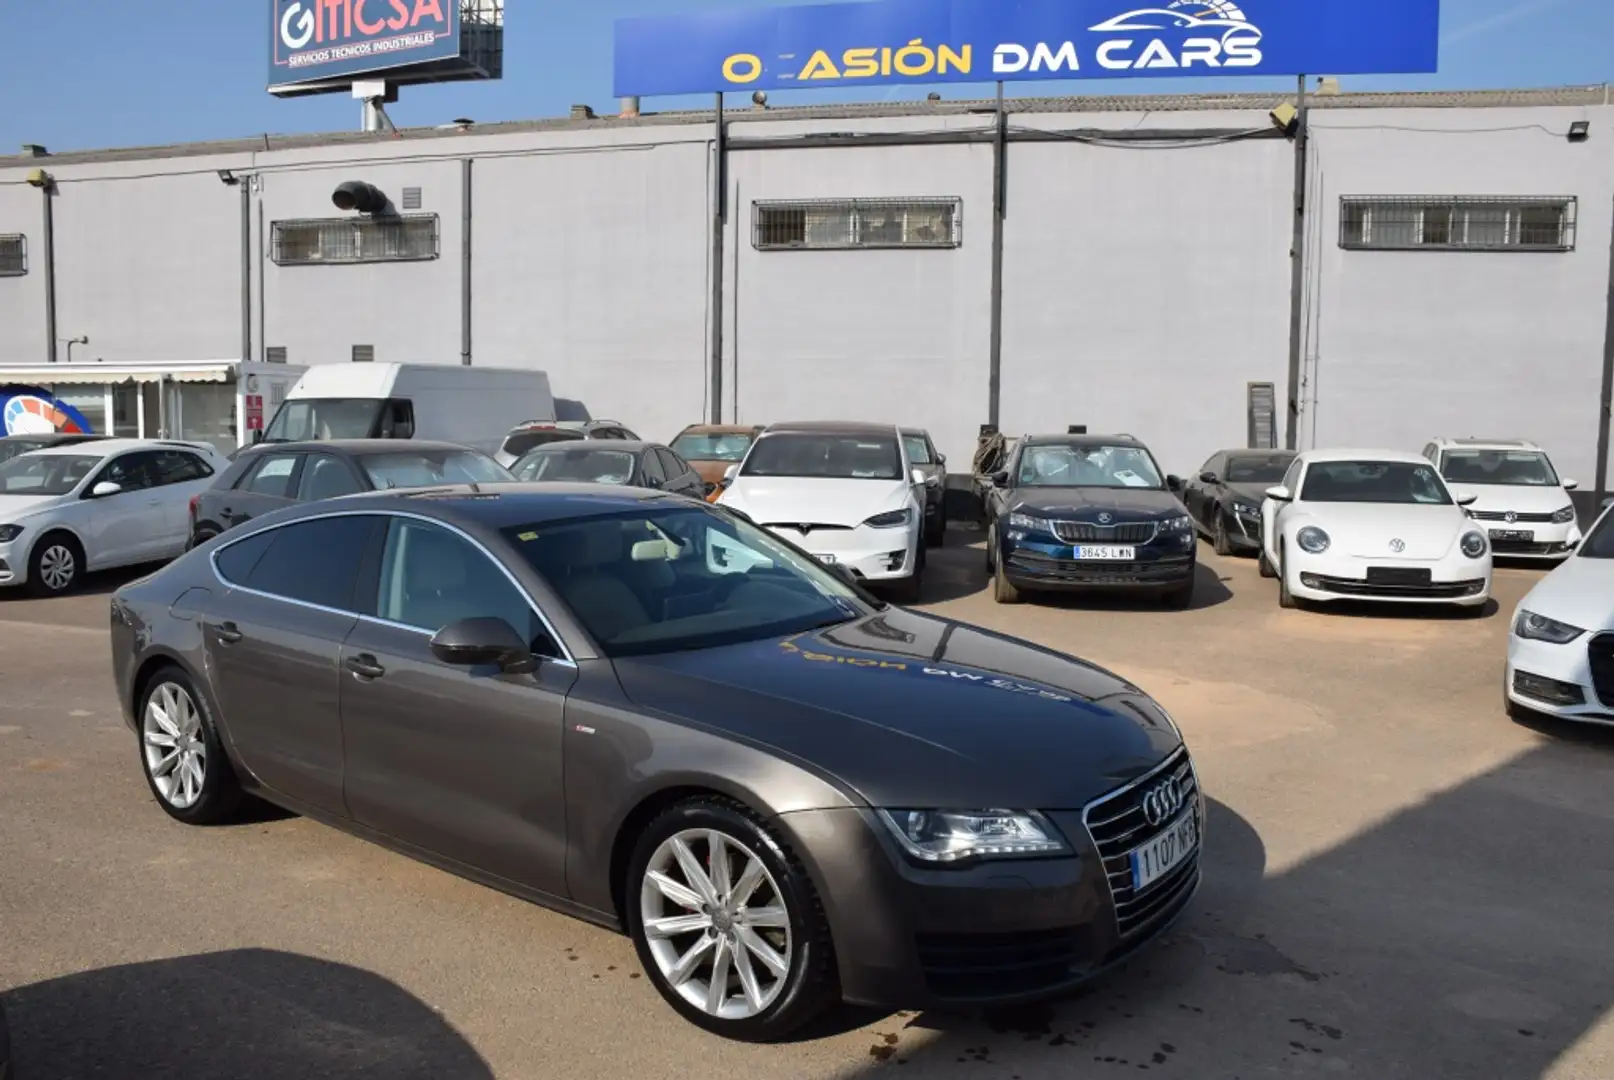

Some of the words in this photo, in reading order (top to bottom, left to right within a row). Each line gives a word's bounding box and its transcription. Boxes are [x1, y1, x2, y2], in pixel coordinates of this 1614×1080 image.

[288, 50, 329, 67] SERVICIOS
[331, 44, 371, 60] TECNICOS
[373, 32, 435, 52] INDUSTRIALES
[992, 41, 1080, 73] DM
[1096, 37, 1263, 69] CARS
[1143, 832, 1176, 878] 1107
